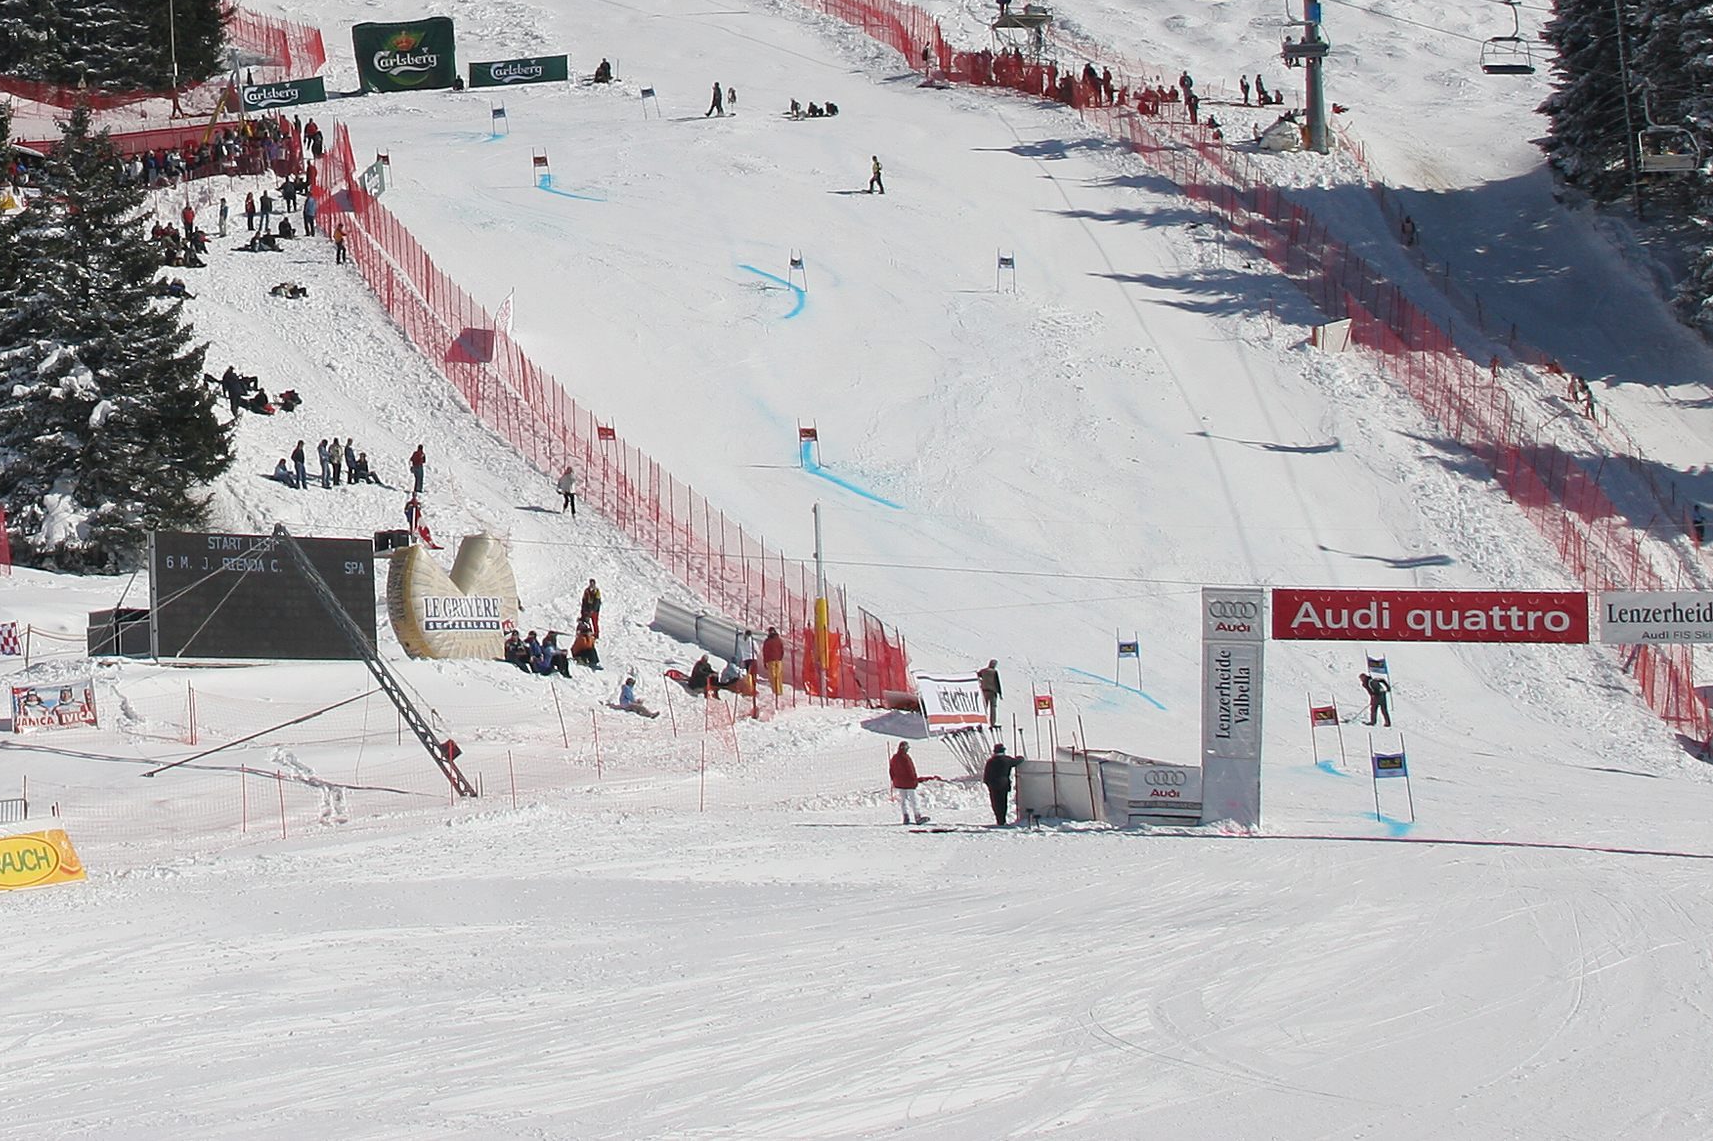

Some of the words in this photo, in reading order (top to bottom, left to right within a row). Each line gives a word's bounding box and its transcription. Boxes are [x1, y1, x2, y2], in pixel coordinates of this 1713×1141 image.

[373, 49, 437, 74] Carlsberg
[490, 62, 542, 80] Carlsberg
[244, 84, 299, 105] Carlsberg
[207, 536, 242, 550] START
[249, 537, 278, 551] LIST
[166, 555, 174, 568] 6
[180, 556, 193, 569] M.
[202, 557, 213, 570] J.
[270, 559, 283, 573] C.
[344, 561, 365, 575] SPA
[424, 597, 441, 618] LE
[443, 594, 500, 618] GRUYÈRE
[428, 621, 498, 630] SWITZERLAND
[1215, 622, 1251, 633] Audi
[1290, 600, 1391, 629] Audi
[1405, 605, 1570, 637] quattro
[1642, 631, 1669, 639] Audi
[1673, 631, 1691, 639] FIS
[1694, 631, 1712, 639] Ski
[1215, 650, 1231, 739] Lenzerheide
[1233, 667, 1251, 724] Valbella
[61, 711, 95, 724] IVICA
[1149, 788, 1180, 799] Audi
